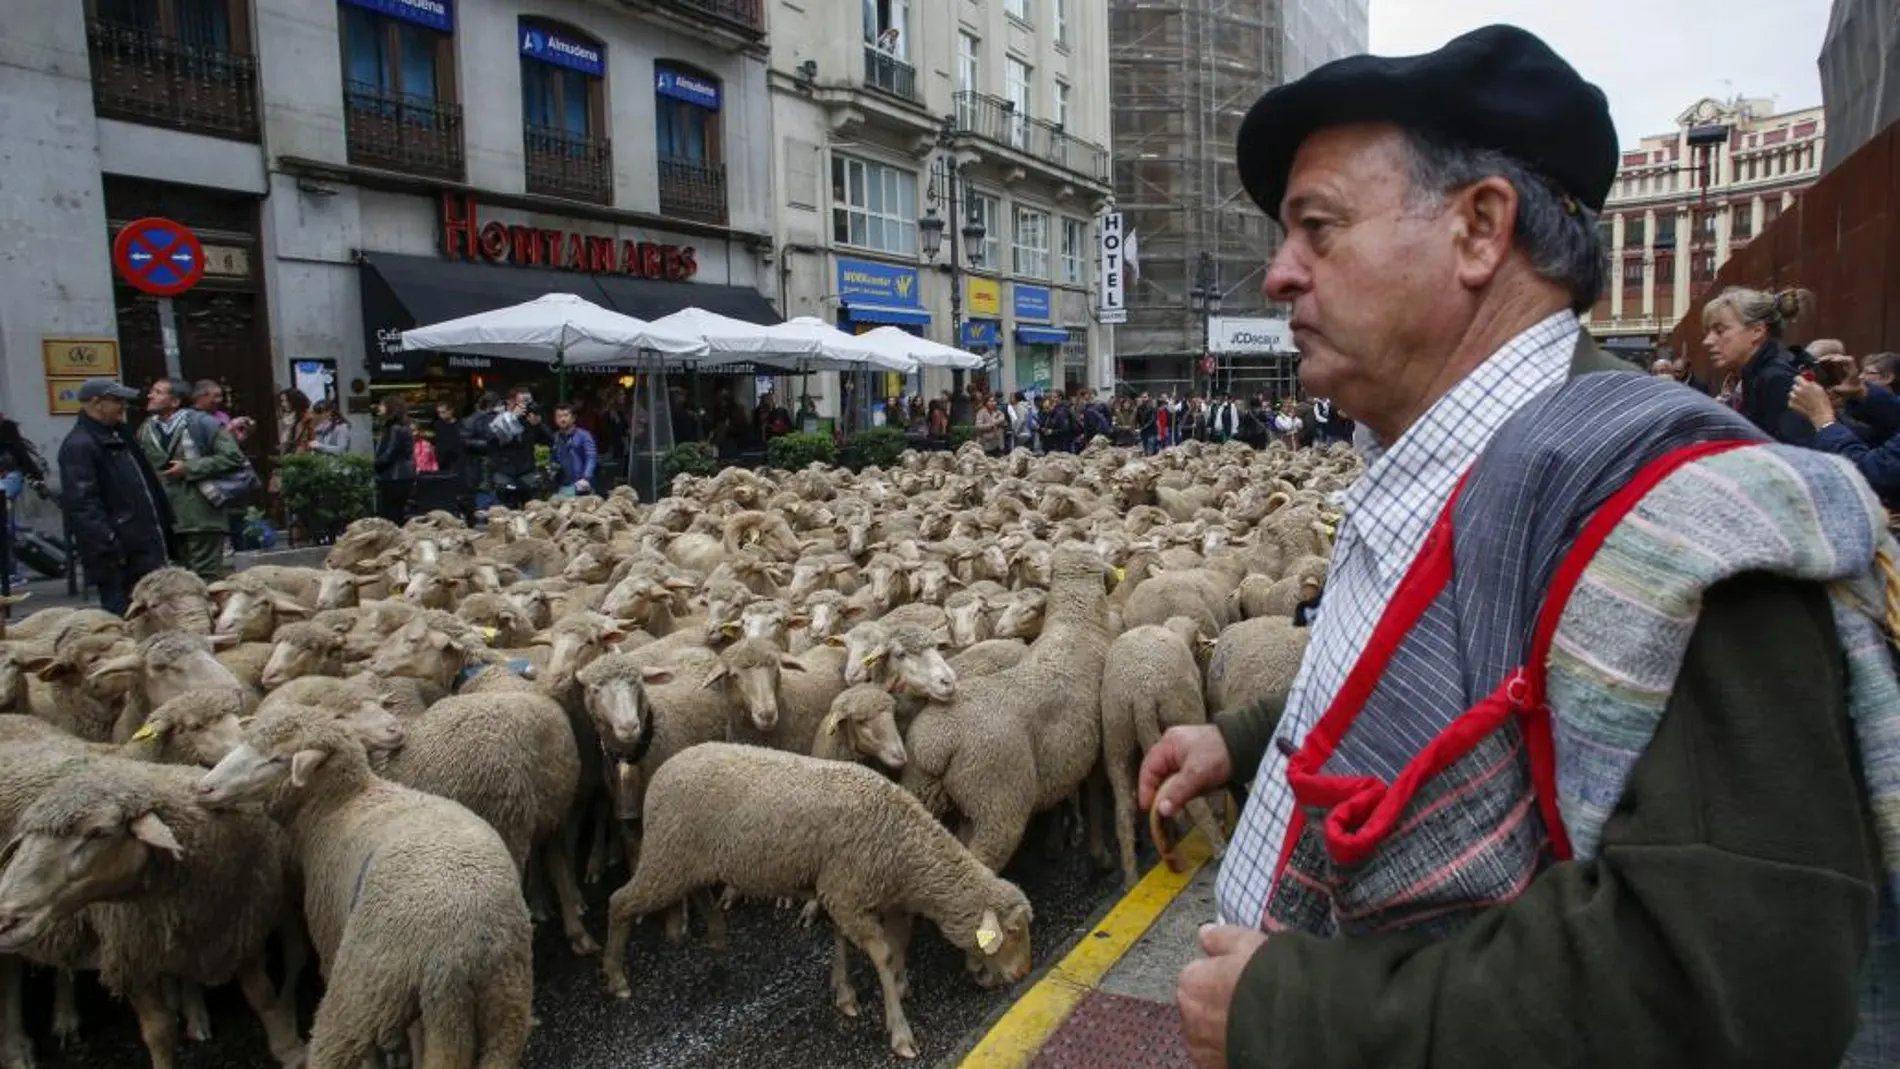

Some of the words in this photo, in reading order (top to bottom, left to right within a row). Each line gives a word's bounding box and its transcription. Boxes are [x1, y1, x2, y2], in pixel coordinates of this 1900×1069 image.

[548, 37, 597, 61] Almudena
[676, 76, 715, 97] Almudena
[1105, 215, 1119, 307] HOTEL
